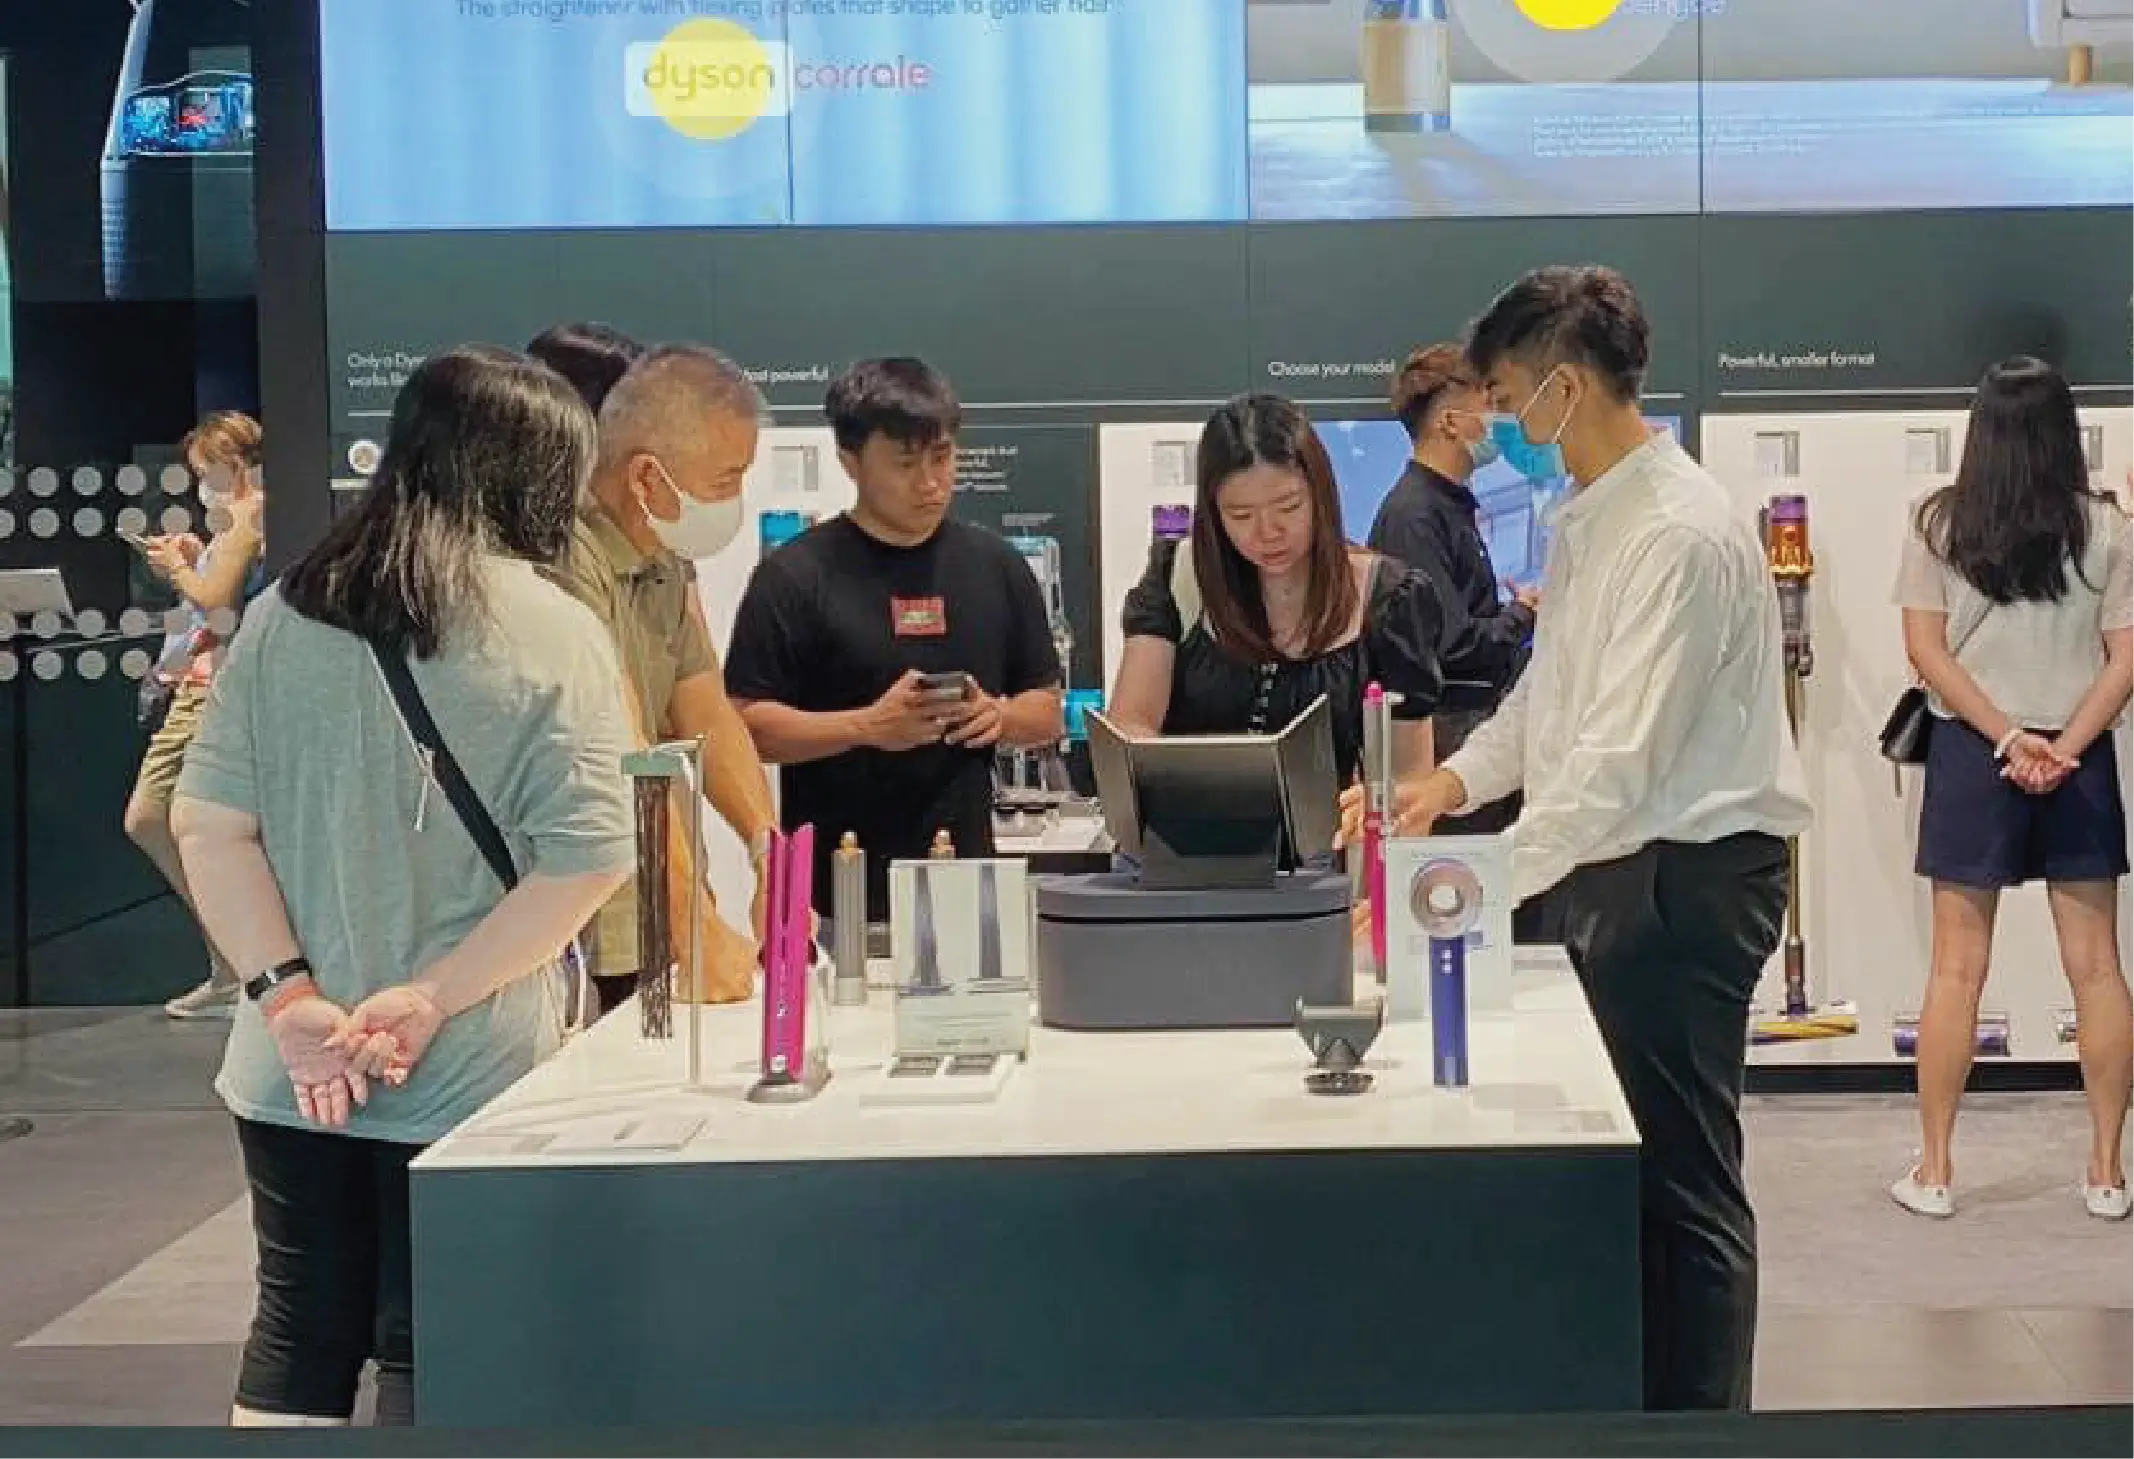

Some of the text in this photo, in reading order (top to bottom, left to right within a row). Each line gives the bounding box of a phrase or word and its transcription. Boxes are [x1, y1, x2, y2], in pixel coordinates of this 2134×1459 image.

[644, 53, 931, 101] dyson corrale
[769, 363, 829, 386] powerful
[1267, 359, 1395, 379] Choose your model
